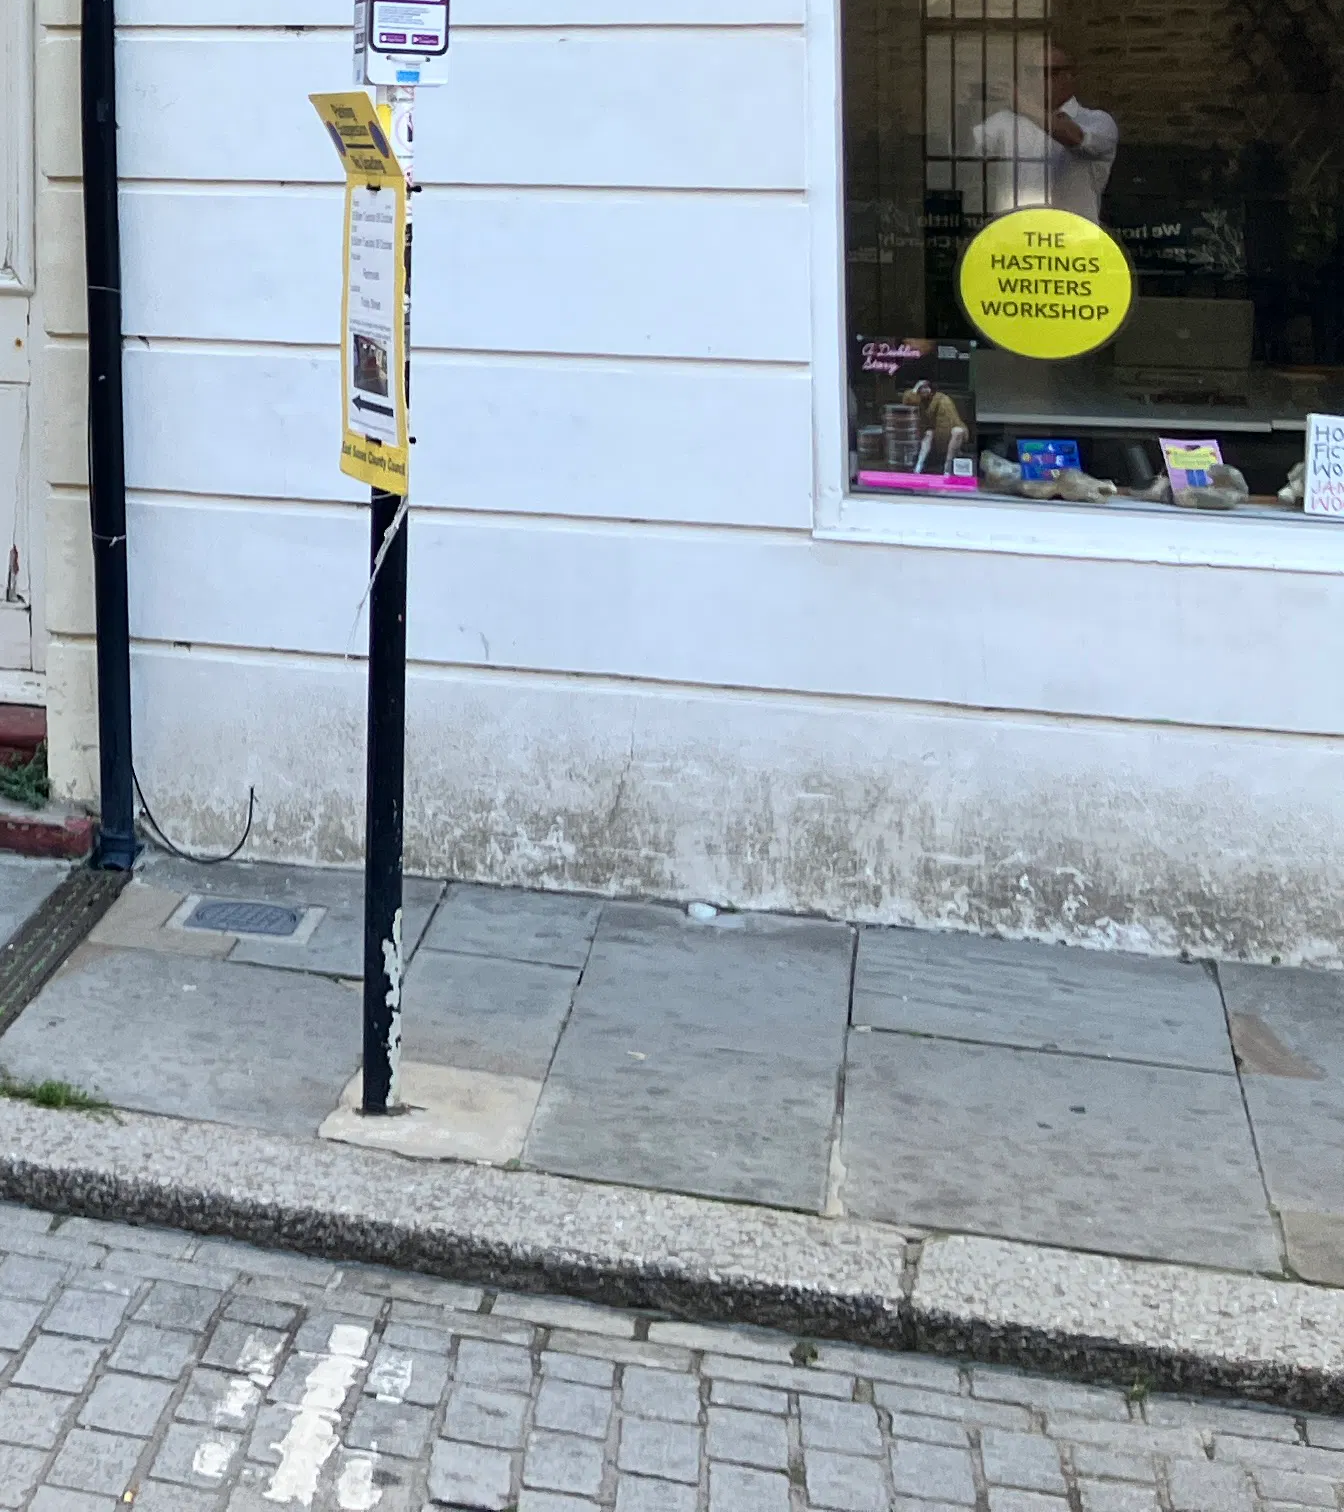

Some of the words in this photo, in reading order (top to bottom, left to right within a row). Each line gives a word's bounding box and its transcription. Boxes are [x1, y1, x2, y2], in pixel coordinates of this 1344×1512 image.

[1024, 231, 1065, 248] THE
[991, 253, 1100, 273] HASTINGS
[998, 277, 1092, 296] WRITERS
[981, 300, 1109, 320] WORKSHOP
[368, 452, 387, 472] County
